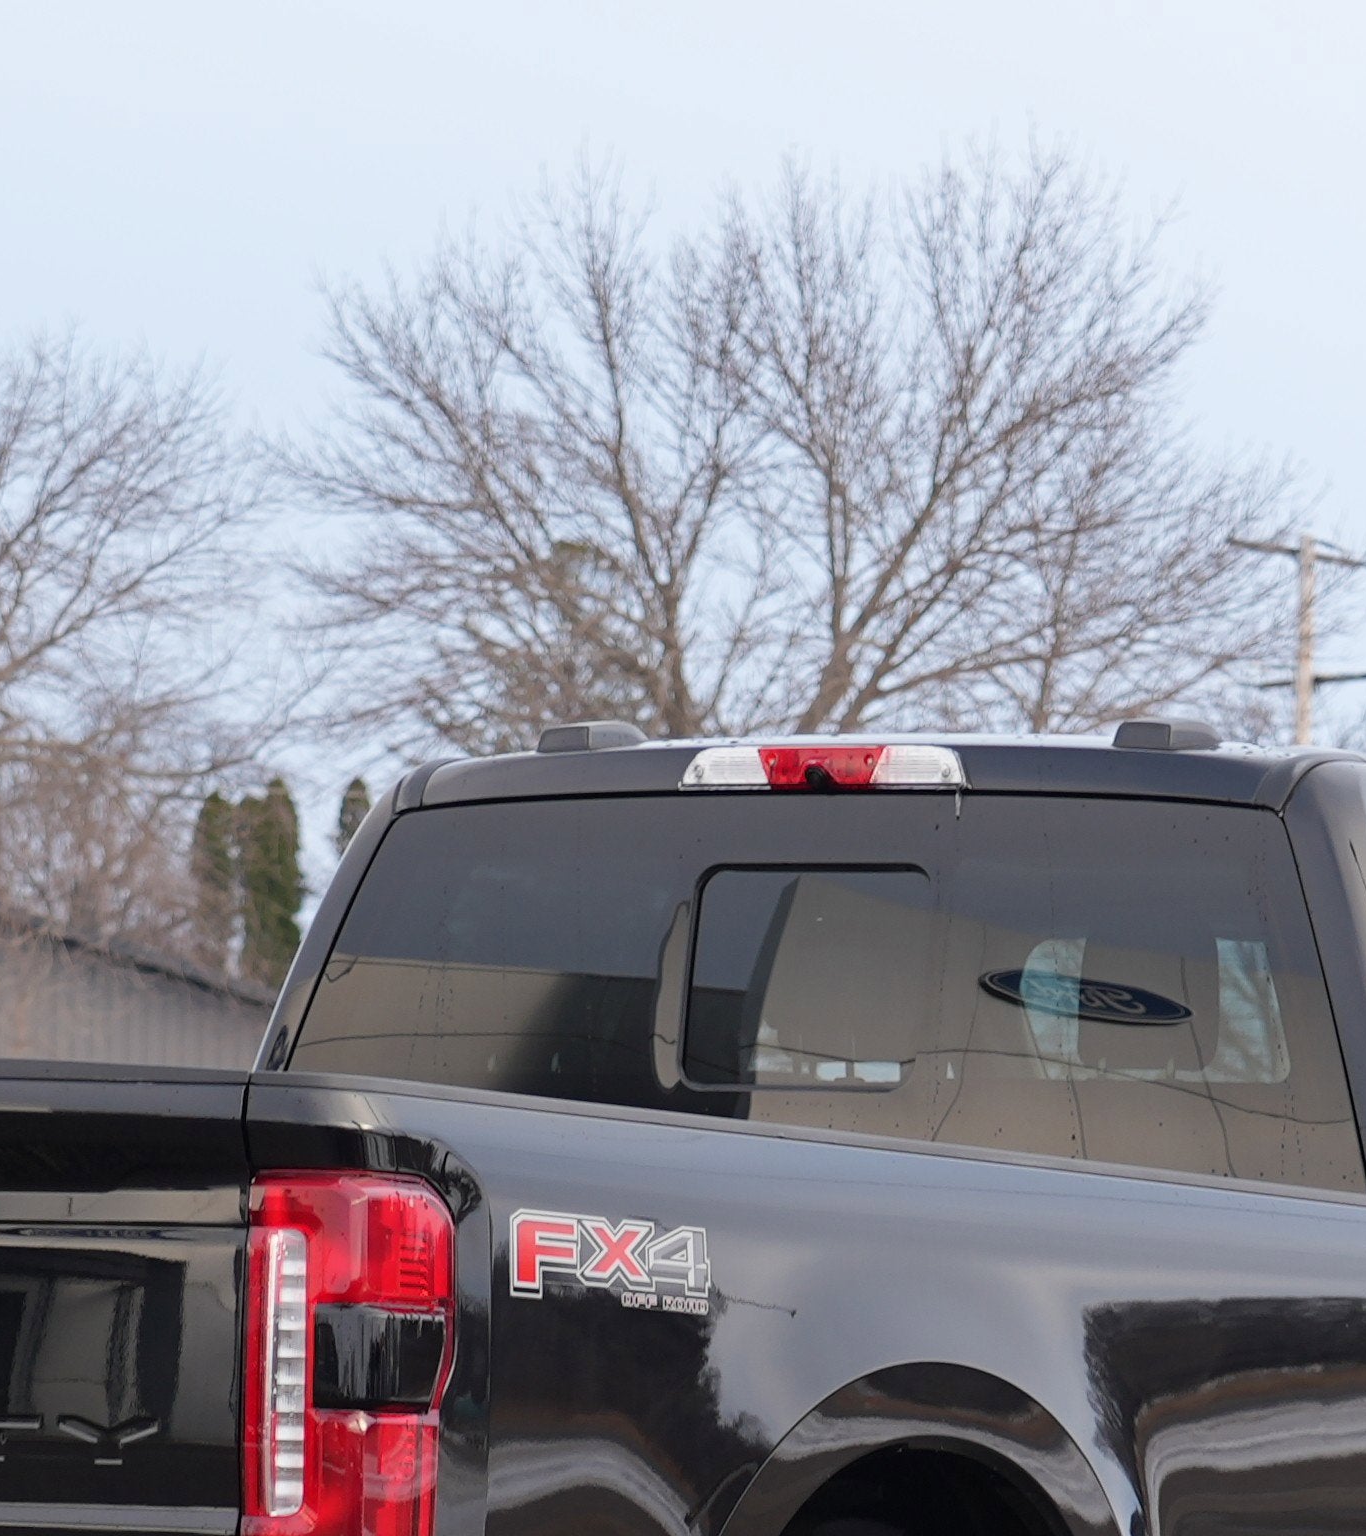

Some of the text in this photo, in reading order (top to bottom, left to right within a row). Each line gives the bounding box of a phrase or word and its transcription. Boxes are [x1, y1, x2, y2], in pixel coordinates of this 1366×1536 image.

[510, 1208, 711, 1298] FX4
[621, 1292, 709, 1316] OFF ROAD
